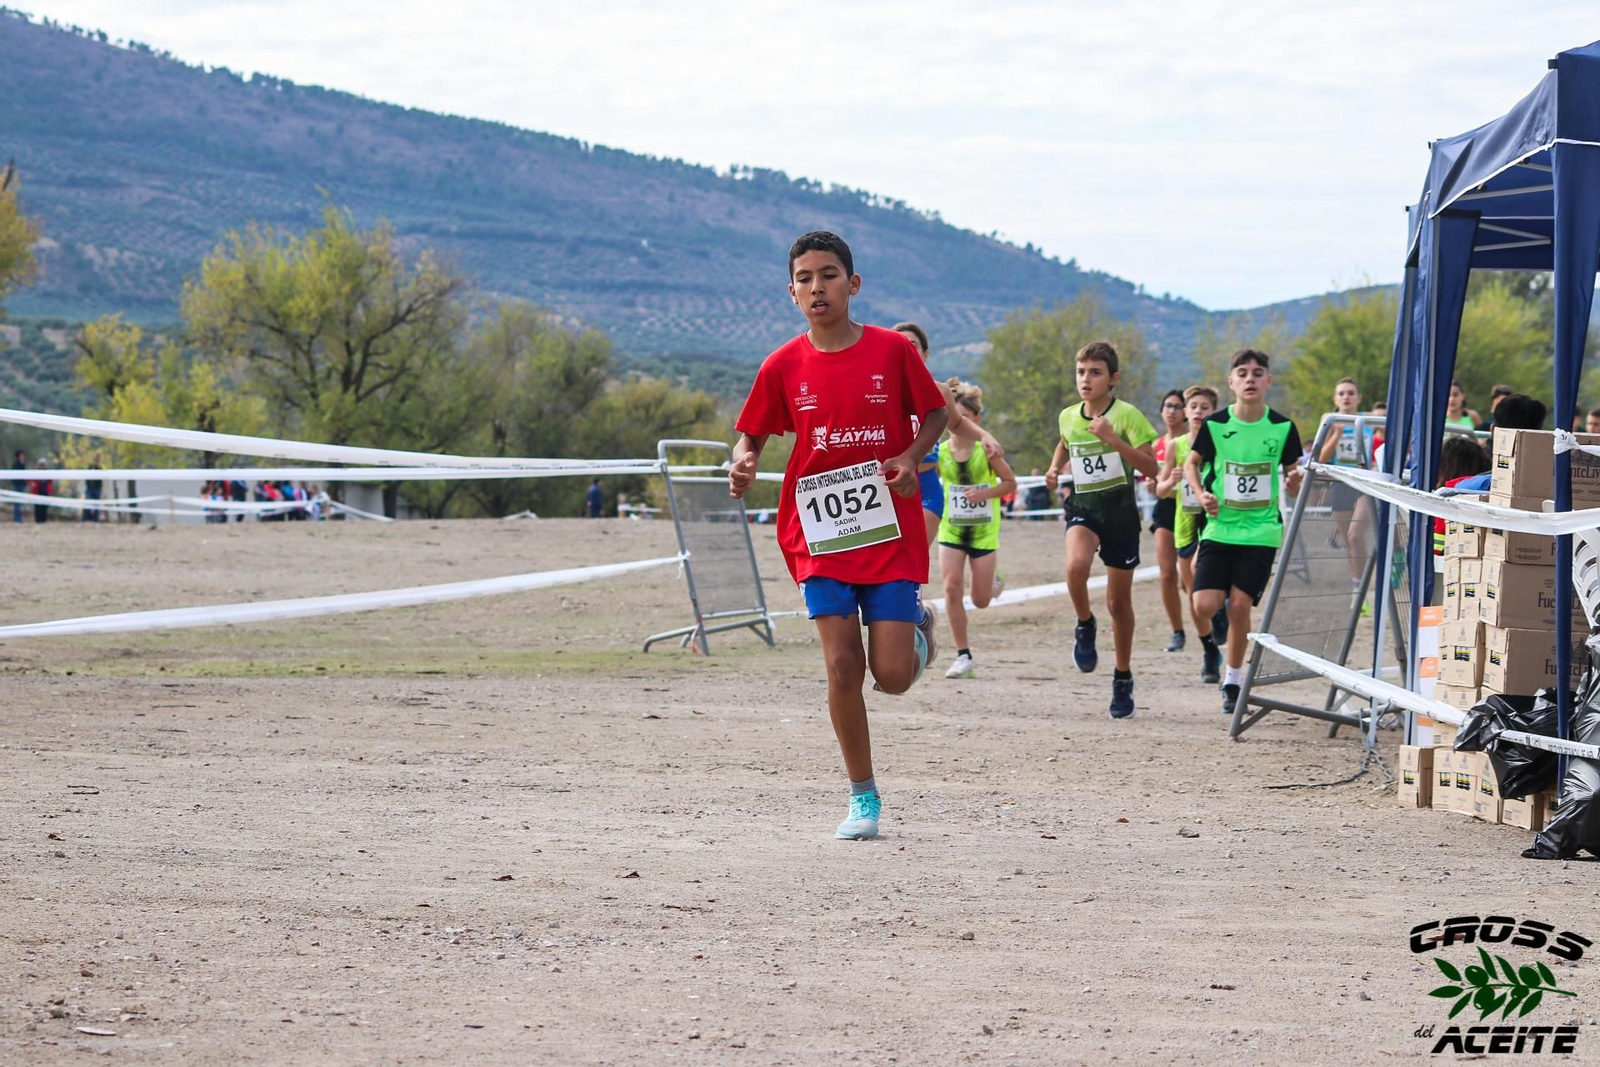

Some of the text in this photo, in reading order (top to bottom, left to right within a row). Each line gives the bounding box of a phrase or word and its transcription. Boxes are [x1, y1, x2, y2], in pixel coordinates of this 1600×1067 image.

[828, 429, 885, 445] SAYMA
[1082, 454, 1107, 475] 84
[801, 476, 818, 493] CROSS
[815, 468, 854, 489] INTERNACIONAL
[852, 465, 864, 481] DEL
[861, 462, 878, 477] ACEITE
[1237, 475, 1258, 494] 82
[806, 483, 882, 523] 1052
[834, 517, 858, 527] SADIKI
[837, 525, 862, 537] ADAM
